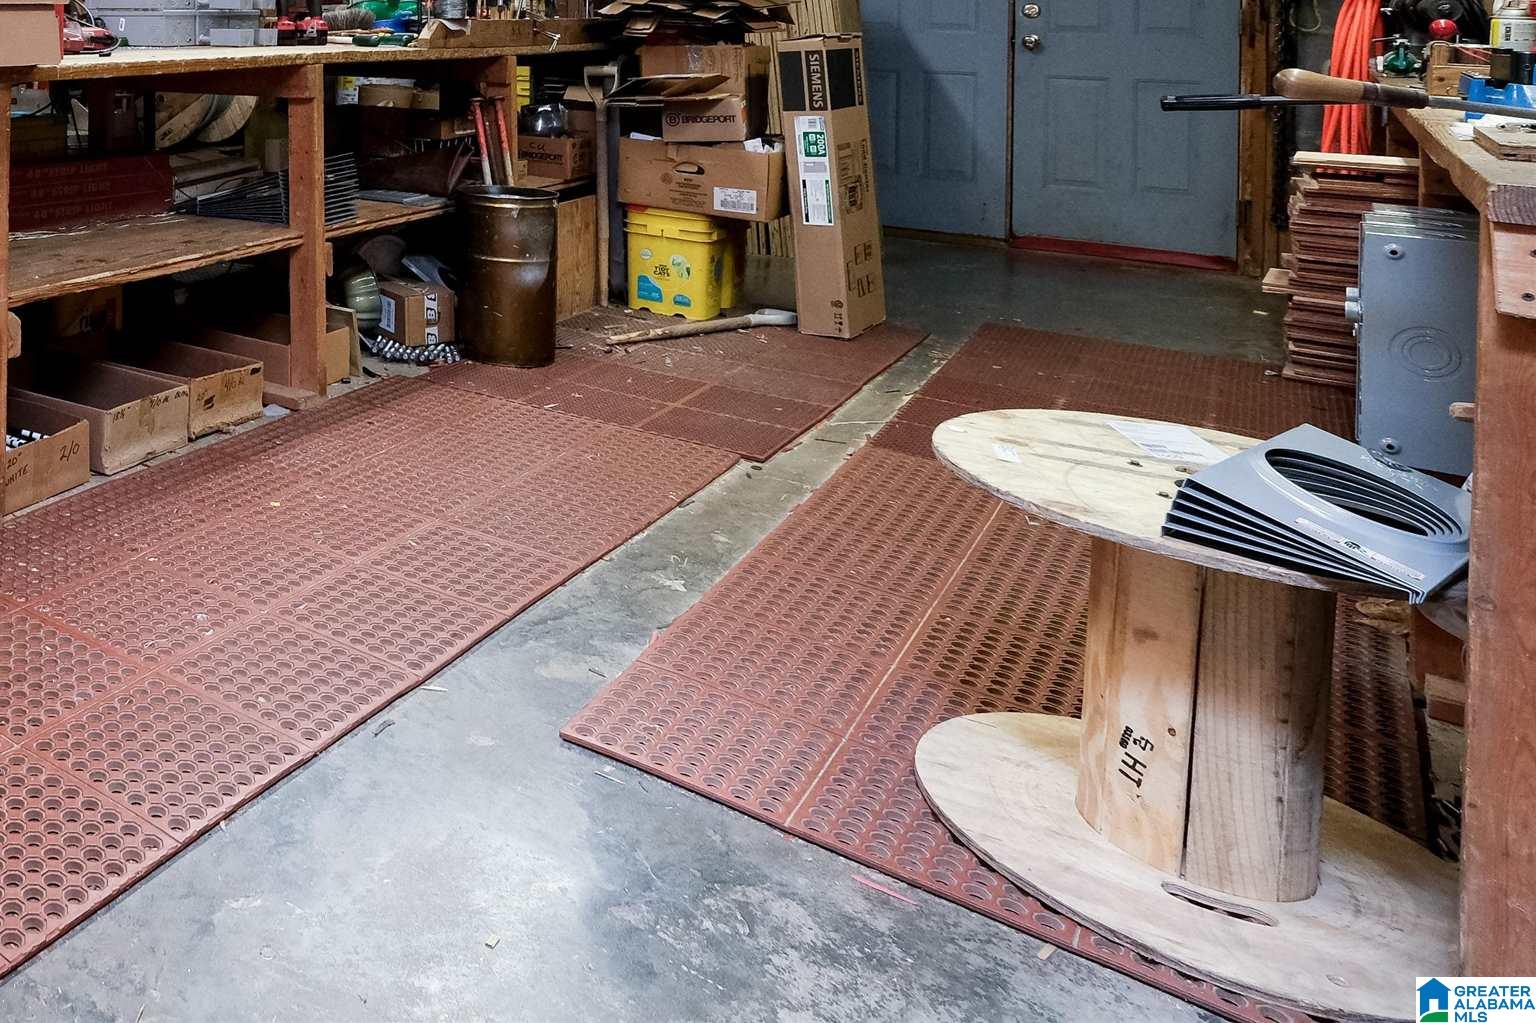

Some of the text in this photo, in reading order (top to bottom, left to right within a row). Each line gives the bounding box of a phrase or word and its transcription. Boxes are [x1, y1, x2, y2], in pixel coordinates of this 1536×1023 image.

[808, 53, 825, 109] SIEMENS
[681, 114, 736, 124] BRIDGEPORT
[816, 134, 826, 156] 200A
[1118, 751, 1147, 788] HT
